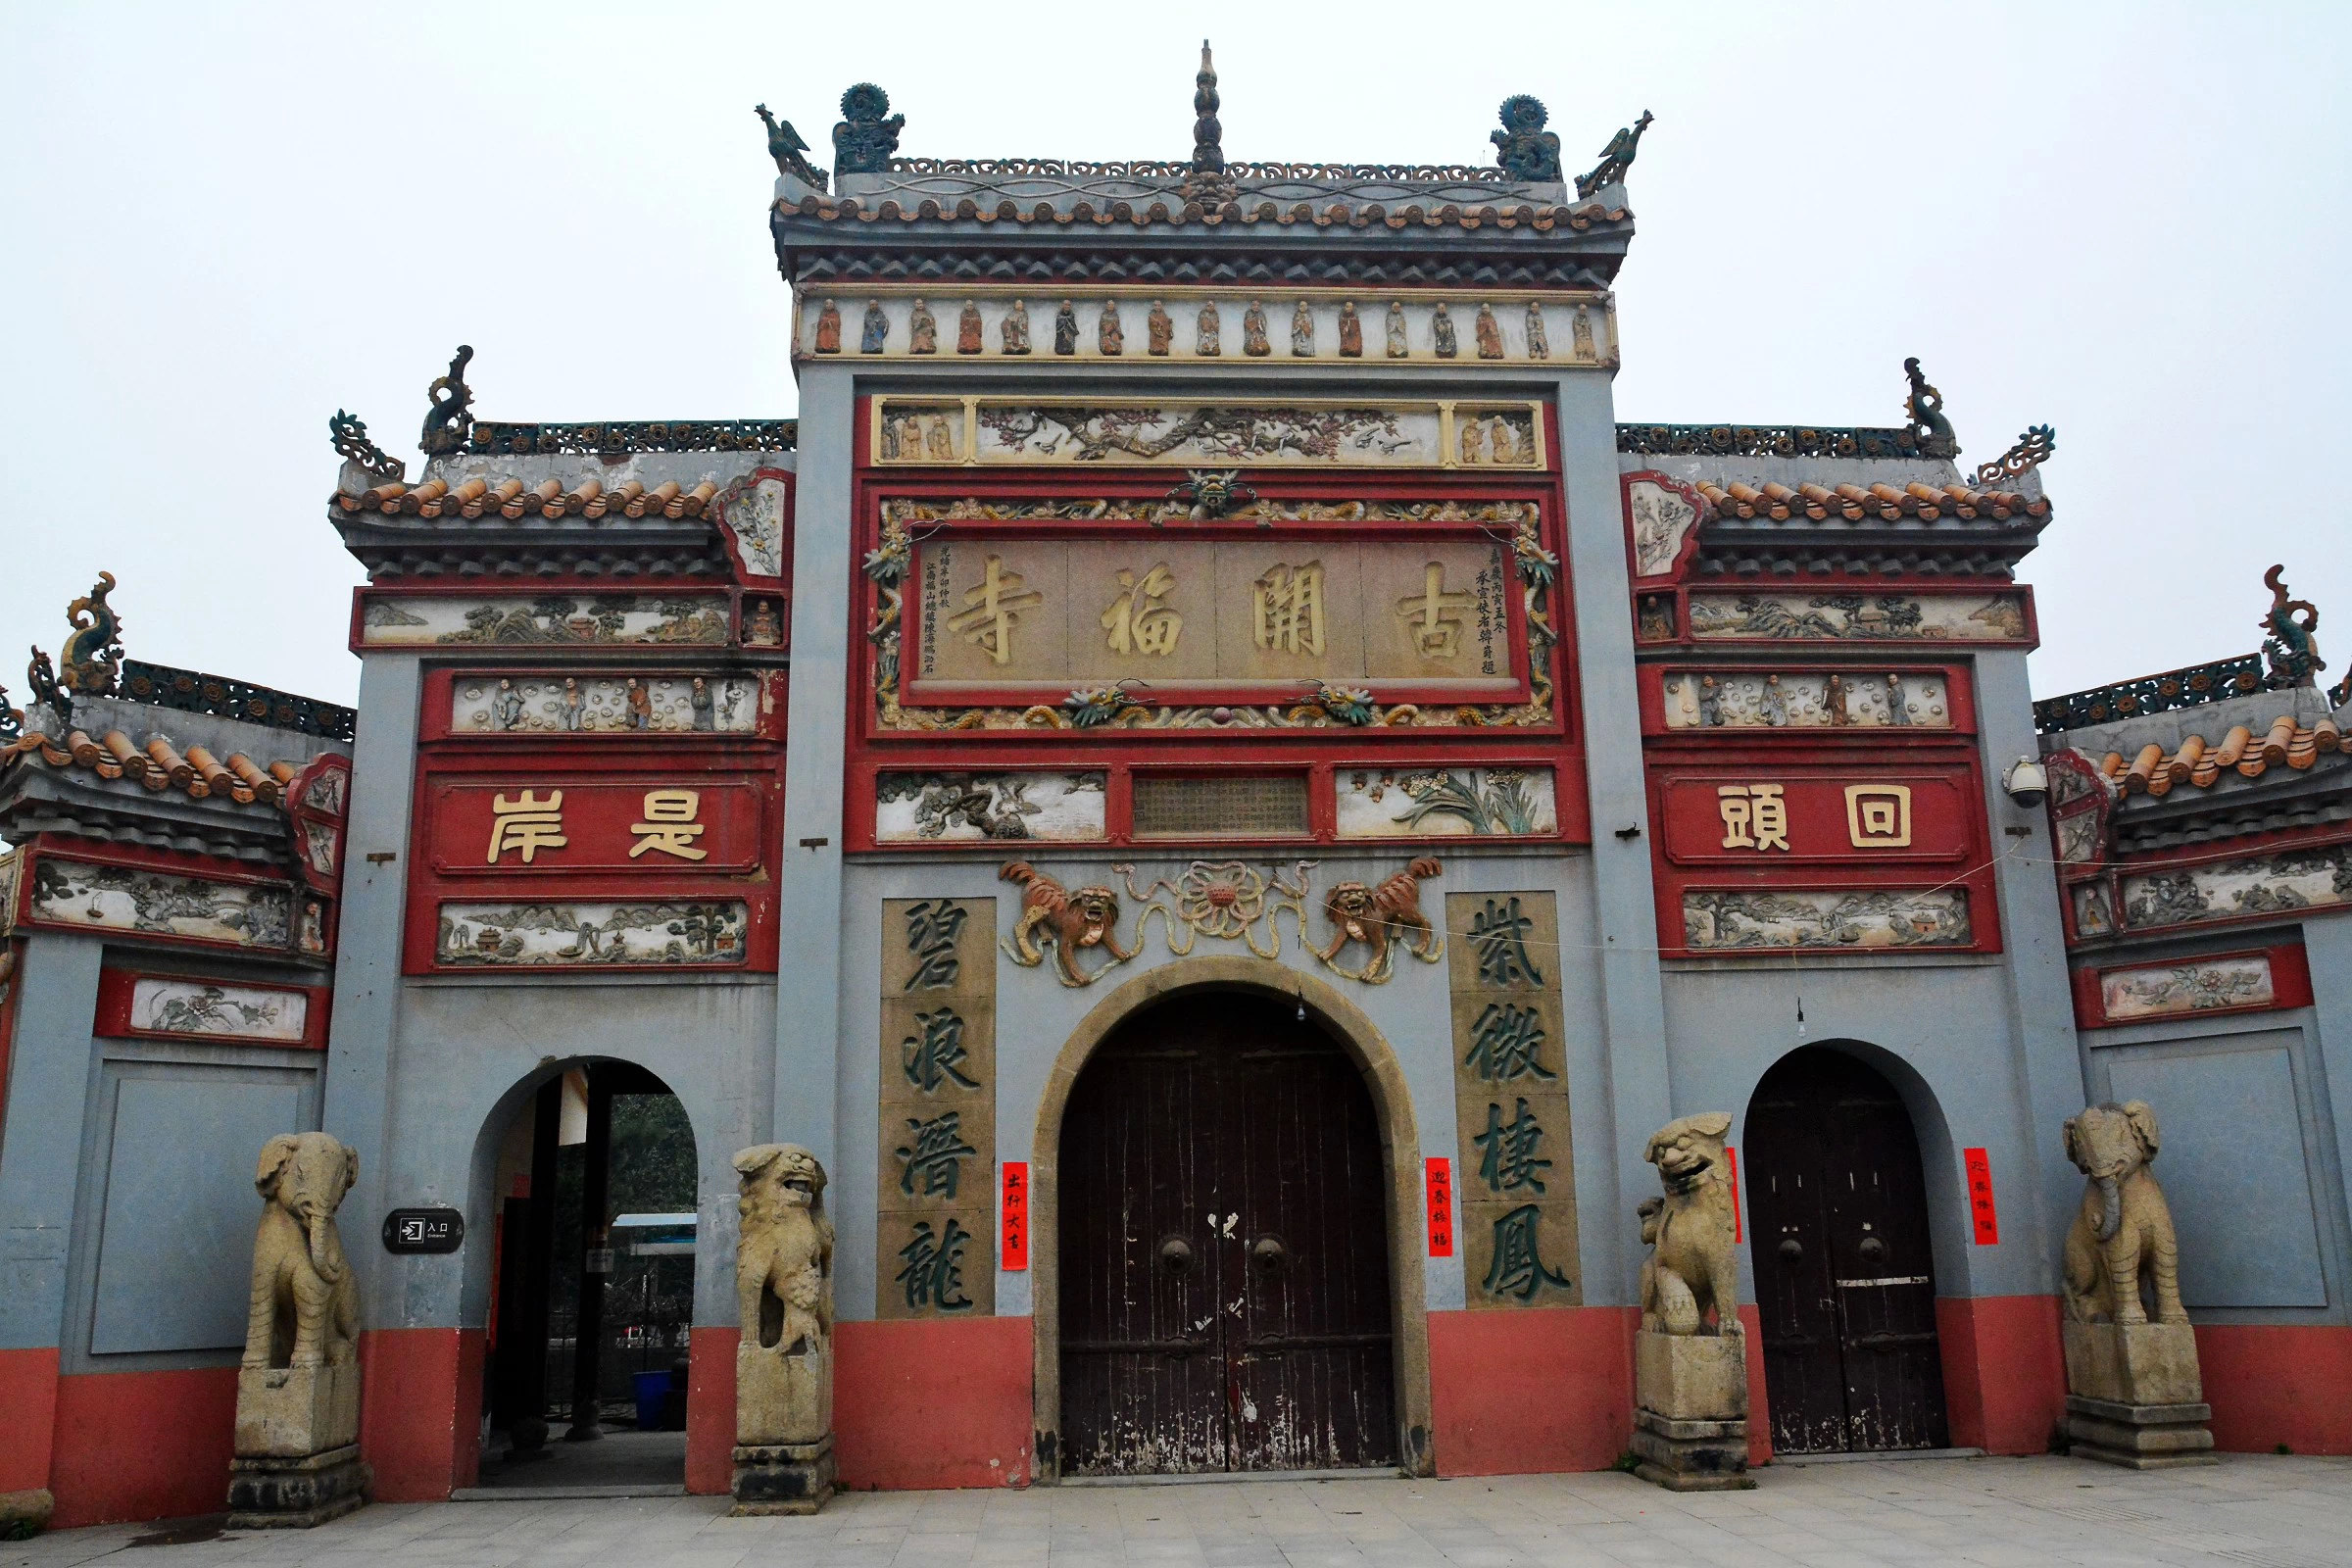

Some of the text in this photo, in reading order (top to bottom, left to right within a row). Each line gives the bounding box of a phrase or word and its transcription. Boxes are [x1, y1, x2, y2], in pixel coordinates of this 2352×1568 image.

[487, 789, 708, 863] 是岸
[1717, 783, 1912, 852] 回頭
[427, 1223, 448, 1233] 入口
[1006, 1174, 1021, 1250] 出行大吉
[1431, 1171, 1447, 1247] 迎春接福
